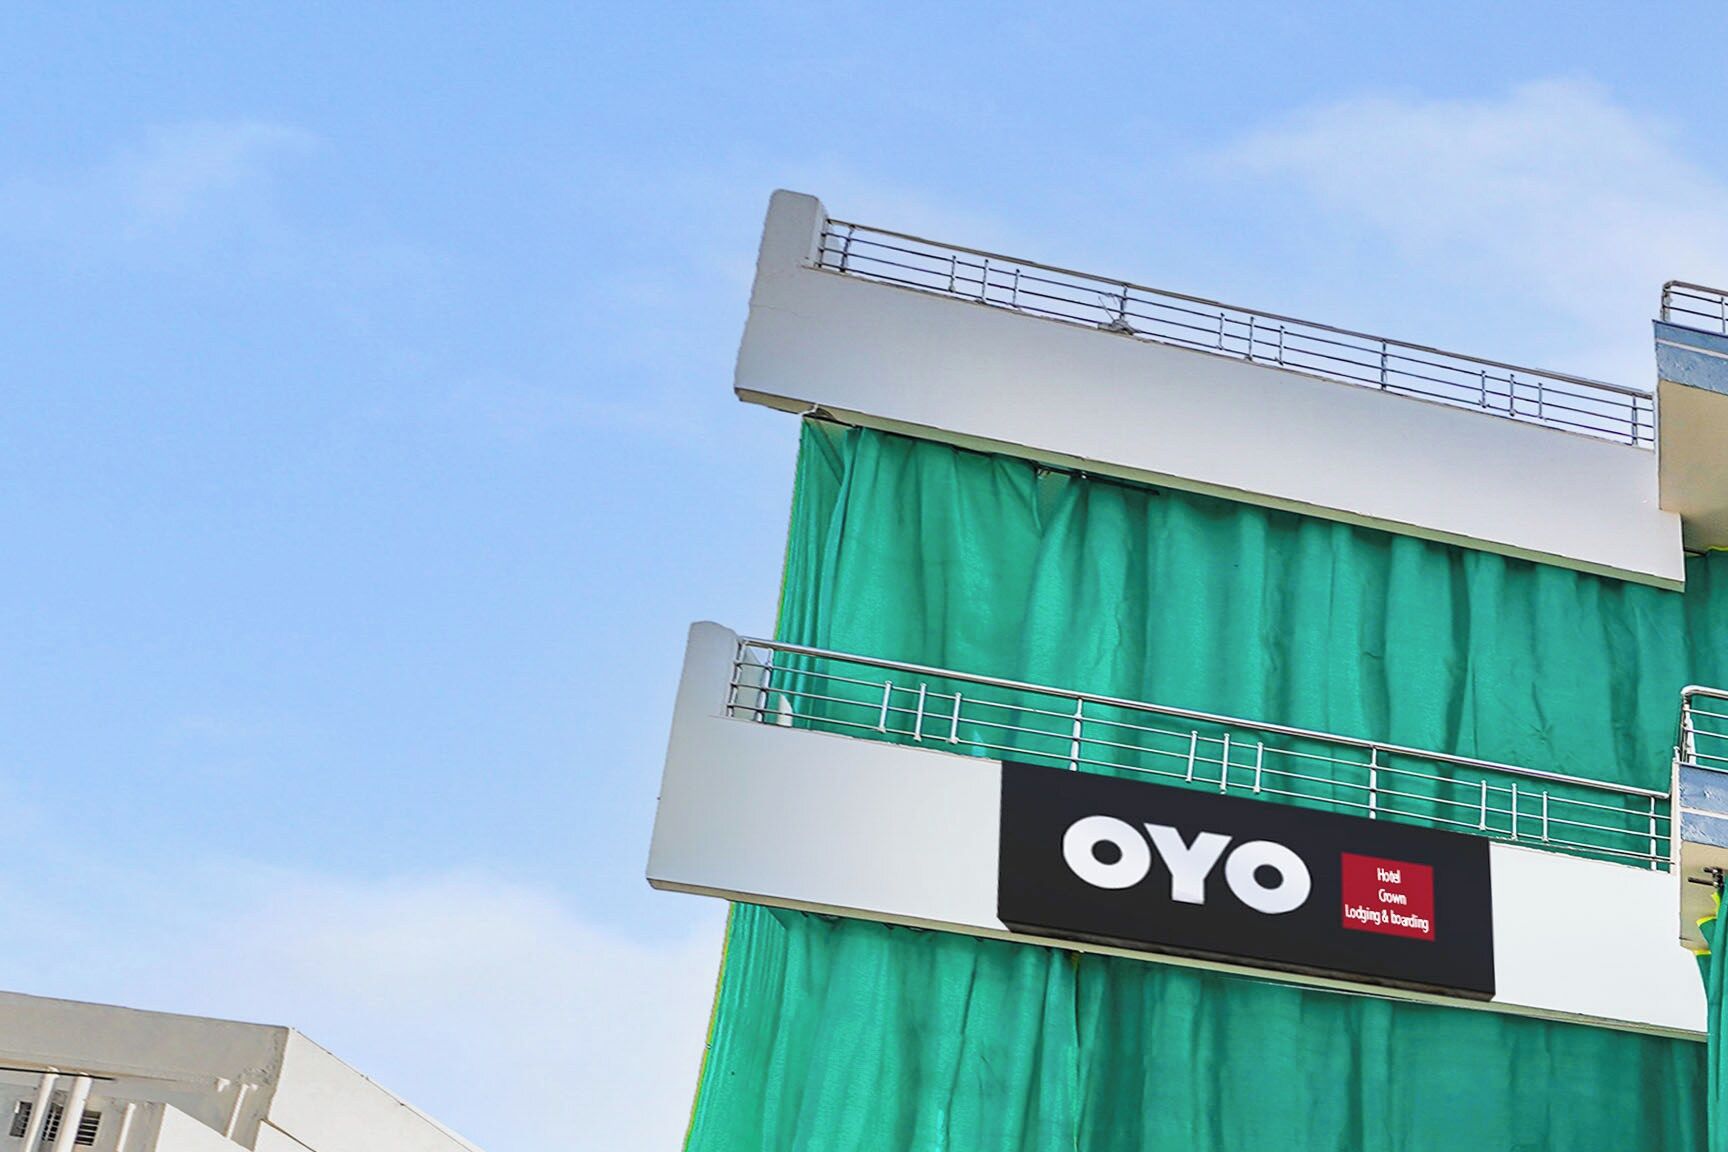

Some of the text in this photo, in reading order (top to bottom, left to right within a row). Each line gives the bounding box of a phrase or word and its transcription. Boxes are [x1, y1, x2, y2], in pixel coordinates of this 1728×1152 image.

[1062, 815, 1312, 914] OYO
[1377, 867, 1401, 884] Hotel
[1378, 888, 1407, 905] Crown
[1344, 904, 1429, 933] Lodging & boarding
